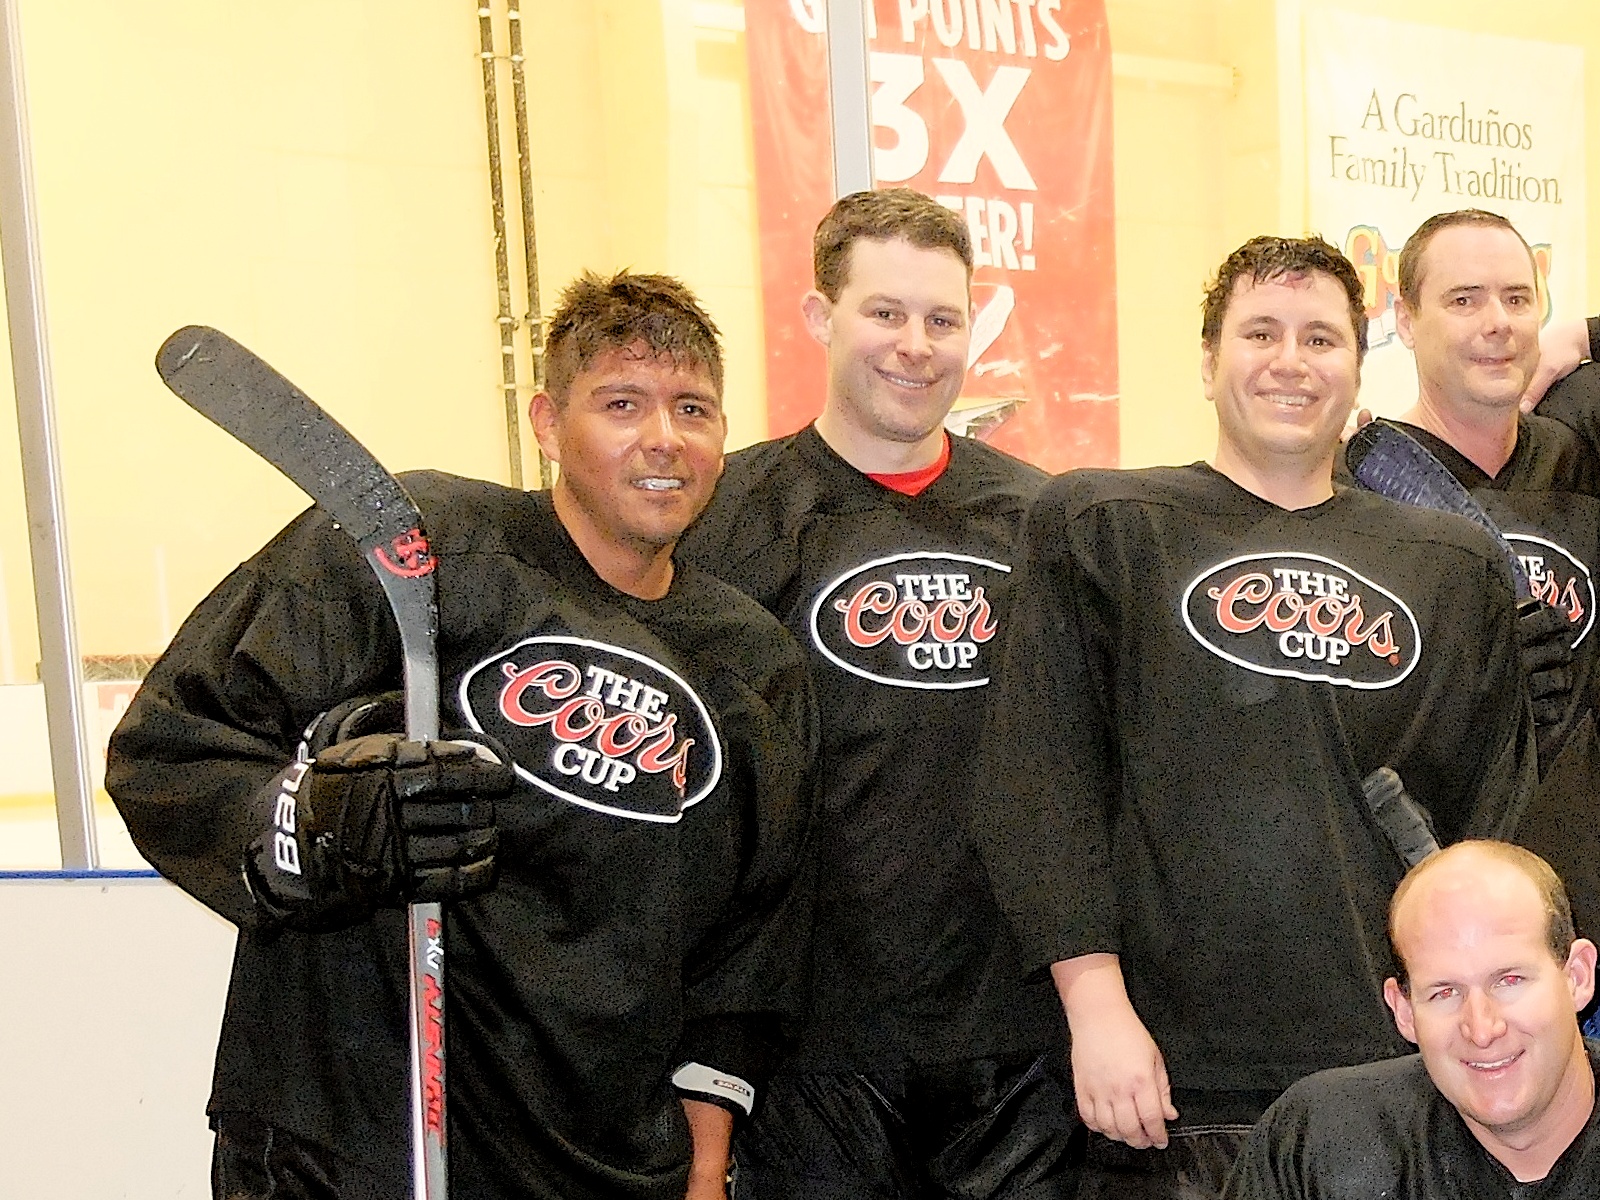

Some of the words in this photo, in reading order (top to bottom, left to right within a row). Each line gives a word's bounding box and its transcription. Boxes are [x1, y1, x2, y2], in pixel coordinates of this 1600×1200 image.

[1361, 88, 1388, 132] A
[1394, 93, 1533, 150] Garduños
[1328, 135, 1427, 202] Family
[1433, 151, 1562, 204] Tradition
[834, 580, 999, 648] Coor
[896, 574, 973, 602] THE
[1273, 567, 1350, 603] THE
[1207, 572, 1400, 660] Coors
[906, 641, 979, 670] CUP
[1278, 630, 1351, 665] CUP
[586, 664, 670, 723] THE
[553, 743, 637, 792] CUP
[424, 974, 446, 1136] DYNASTY
